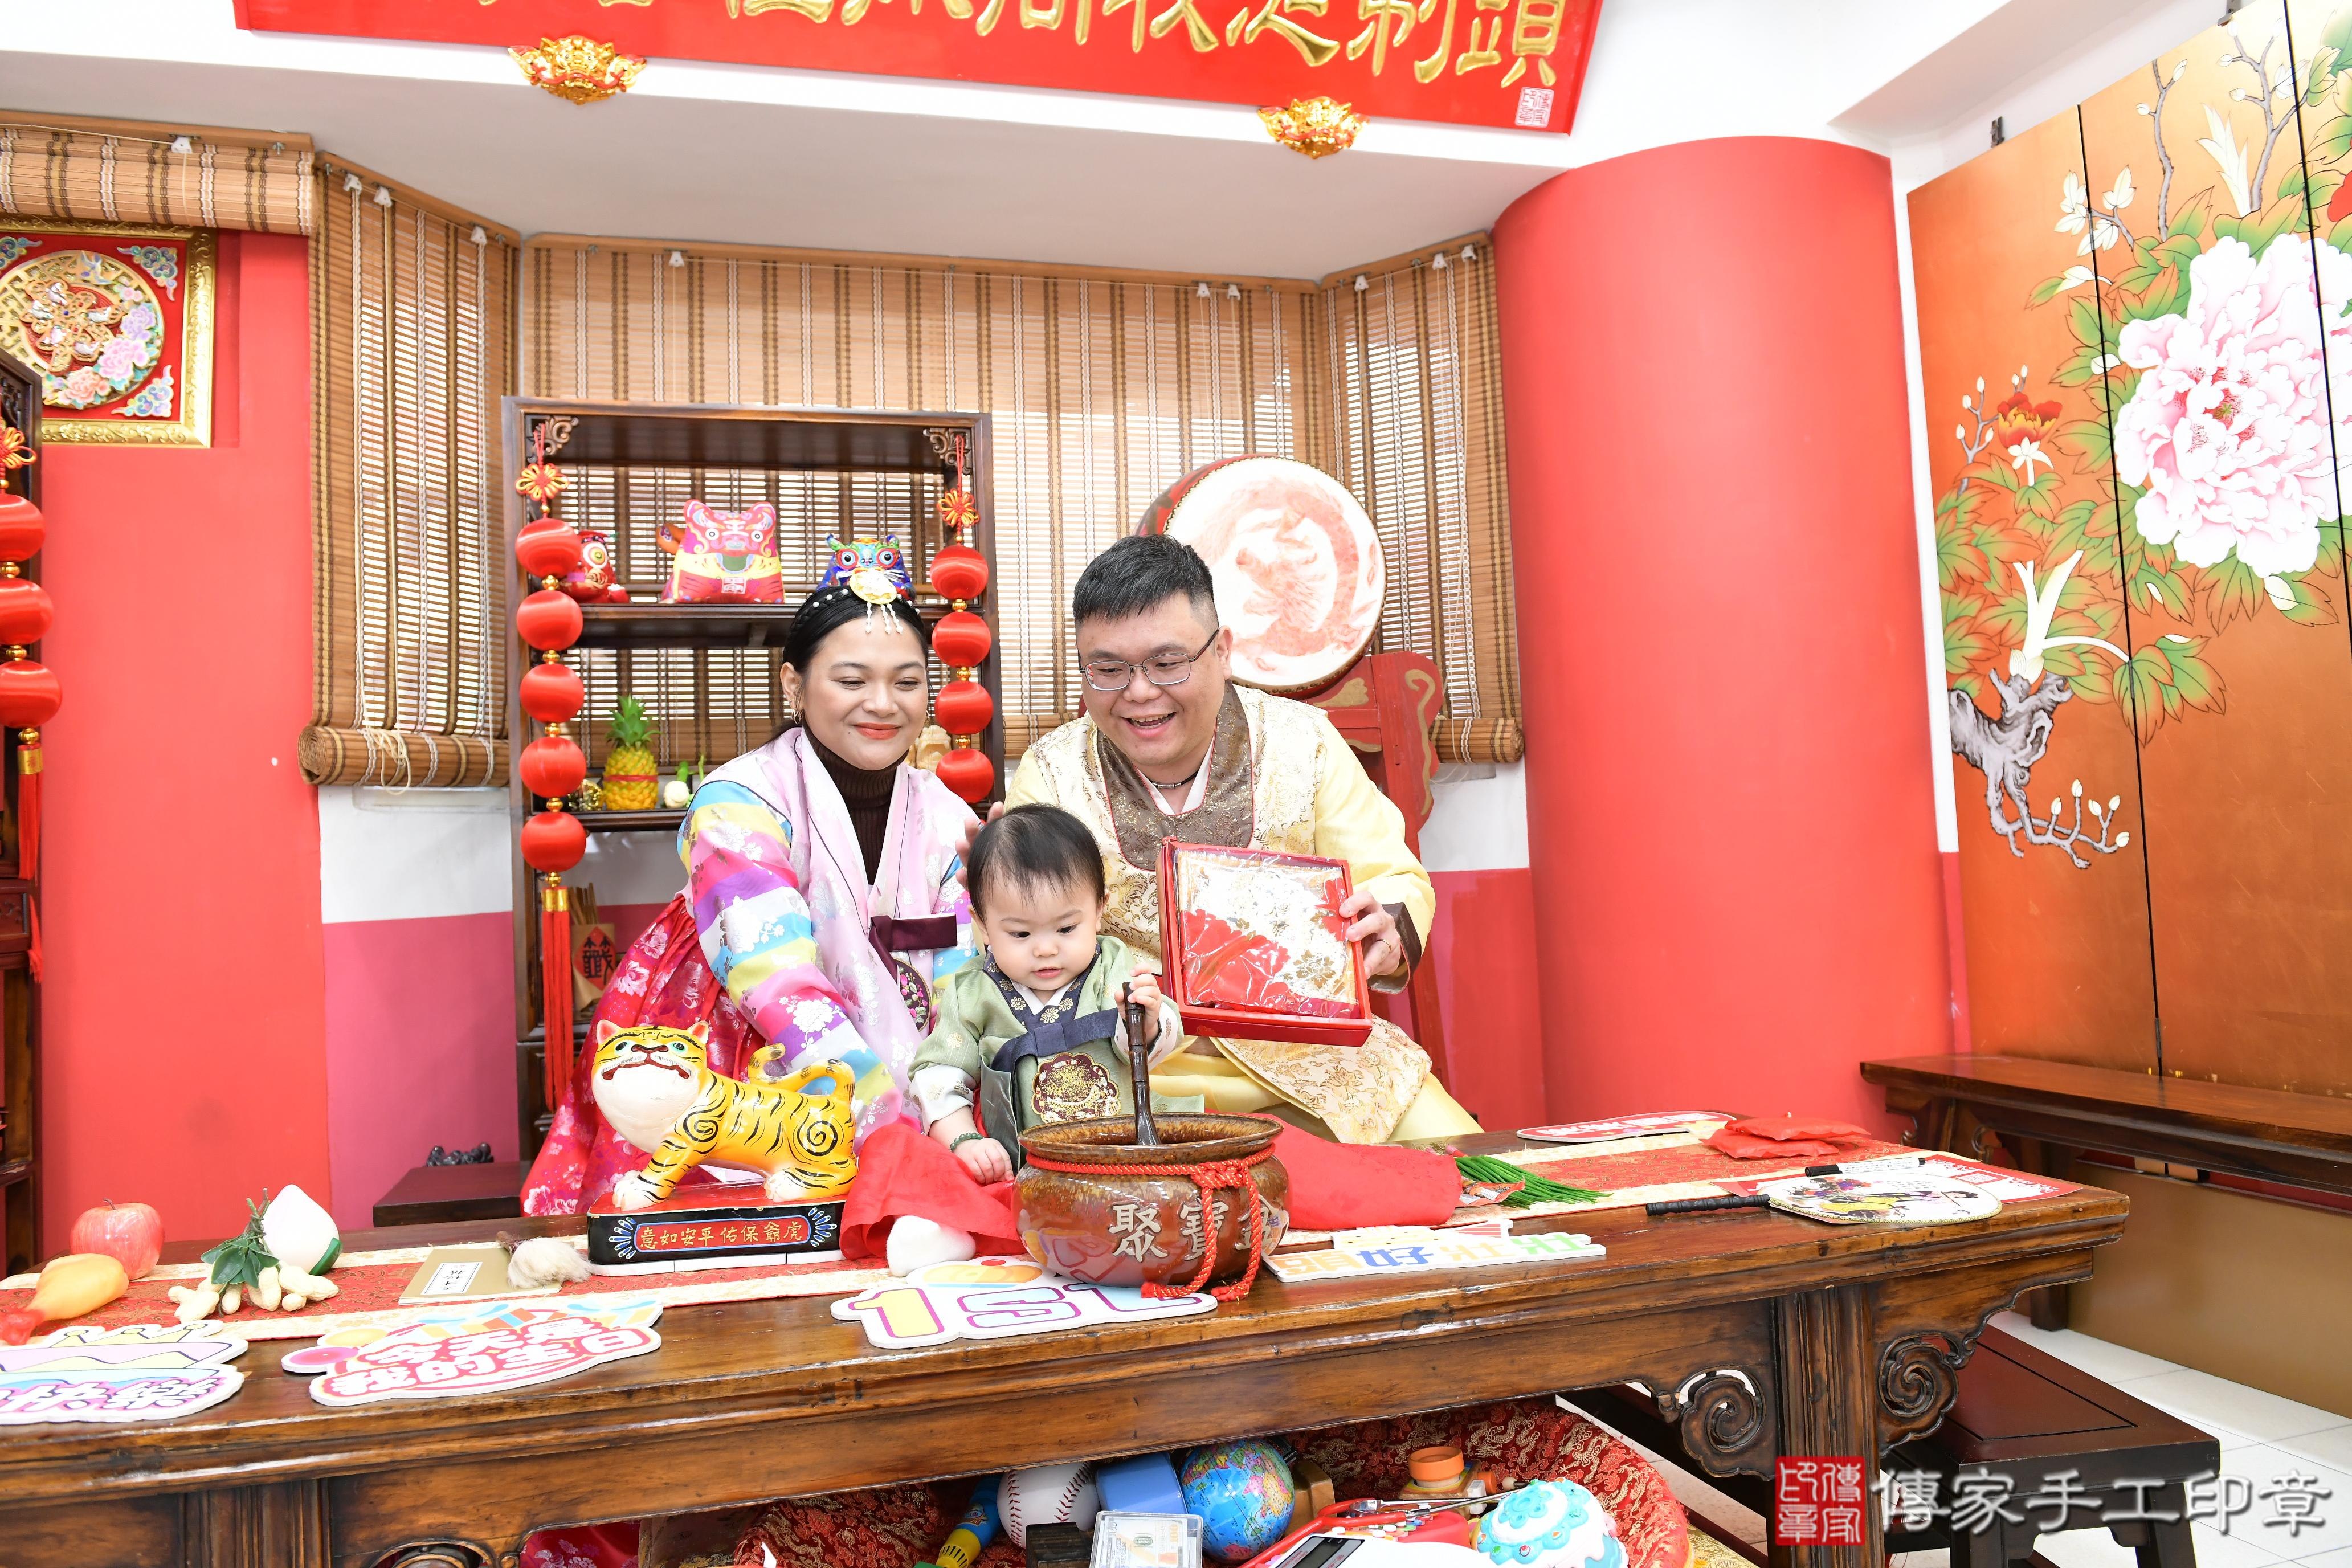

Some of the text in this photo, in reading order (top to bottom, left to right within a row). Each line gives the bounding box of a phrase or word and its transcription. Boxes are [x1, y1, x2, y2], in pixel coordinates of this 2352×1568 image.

[1271, 1233, 1592, 1276] 頭好壯壯
[330, 1329, 644, 1396] 我的生日
[364, 1317, 606, 1364] 今天是
